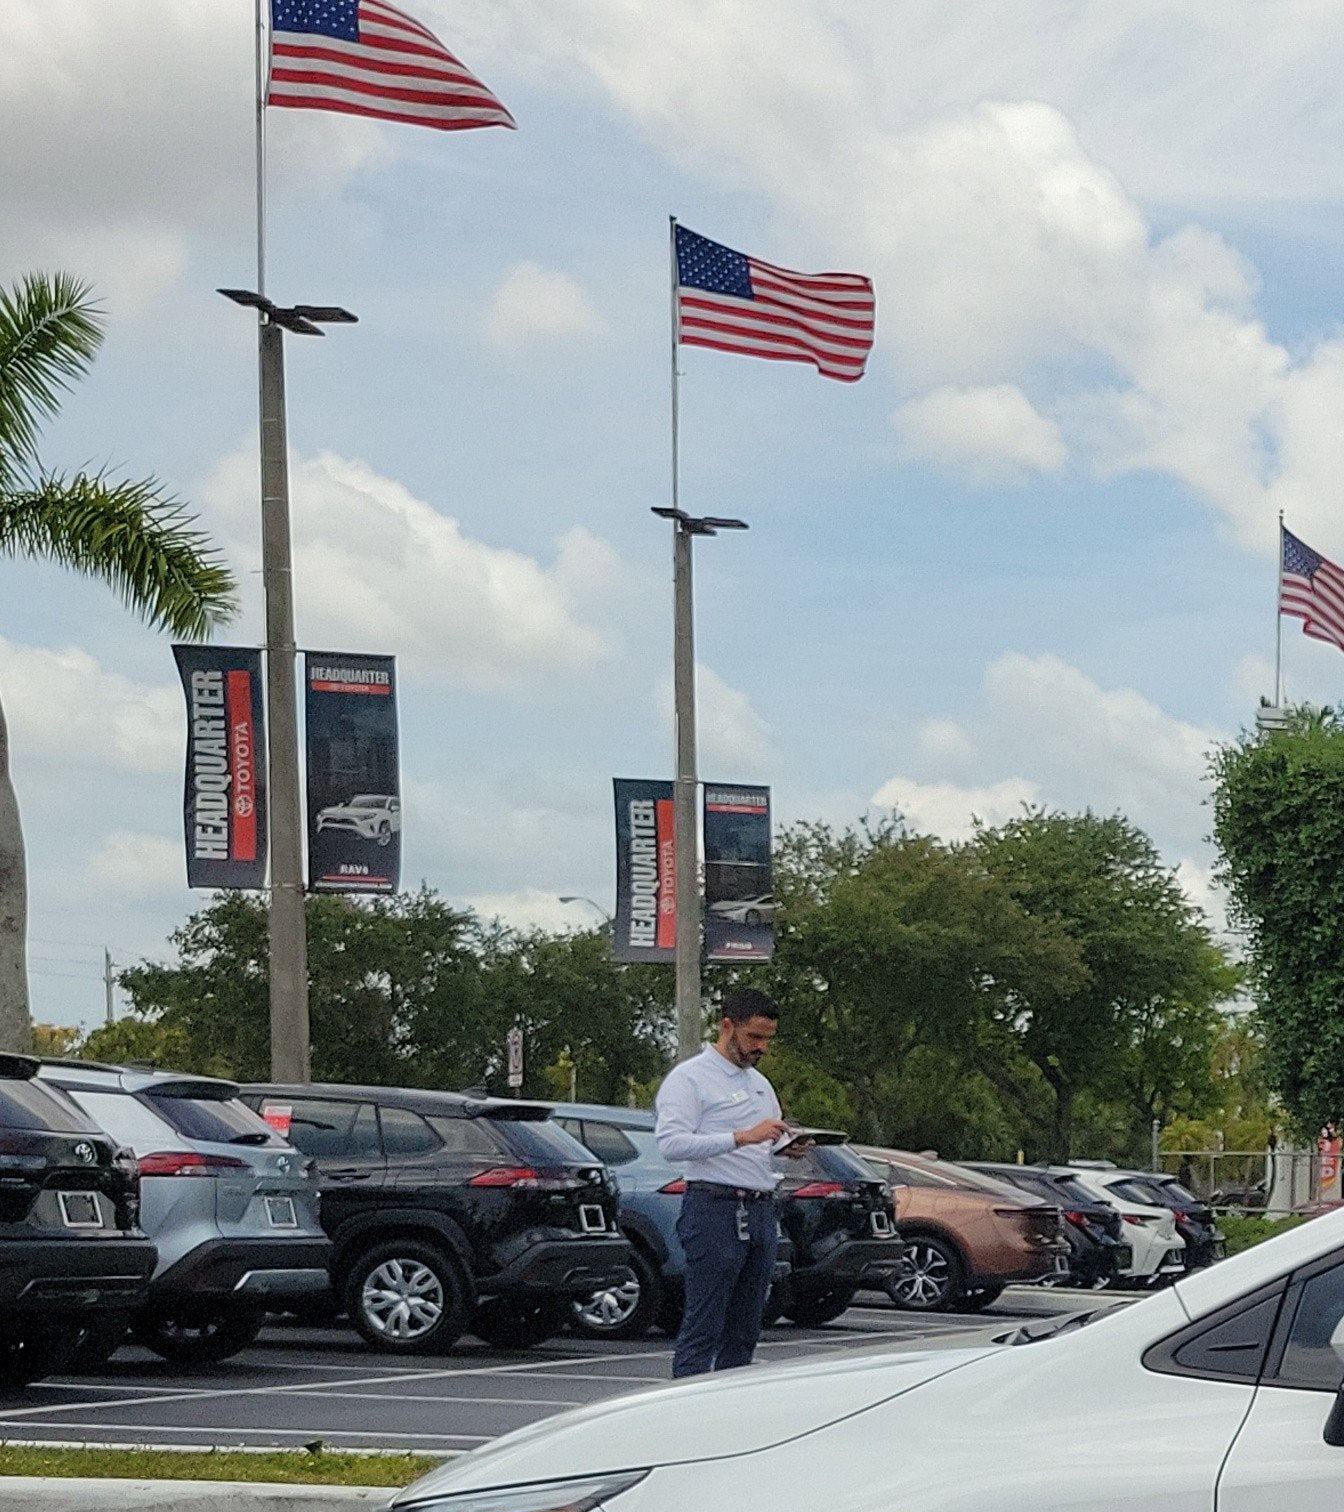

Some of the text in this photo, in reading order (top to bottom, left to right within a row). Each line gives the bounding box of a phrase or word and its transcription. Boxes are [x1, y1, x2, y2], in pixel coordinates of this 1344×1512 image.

[311, 667, 389, 684] HEADQUARTER
[192, 670, 231, 860] HEADQUARTER
[235, 722, 251, 793] TOYOTA
[629, 800, 660, 947] HEADQUARTER
